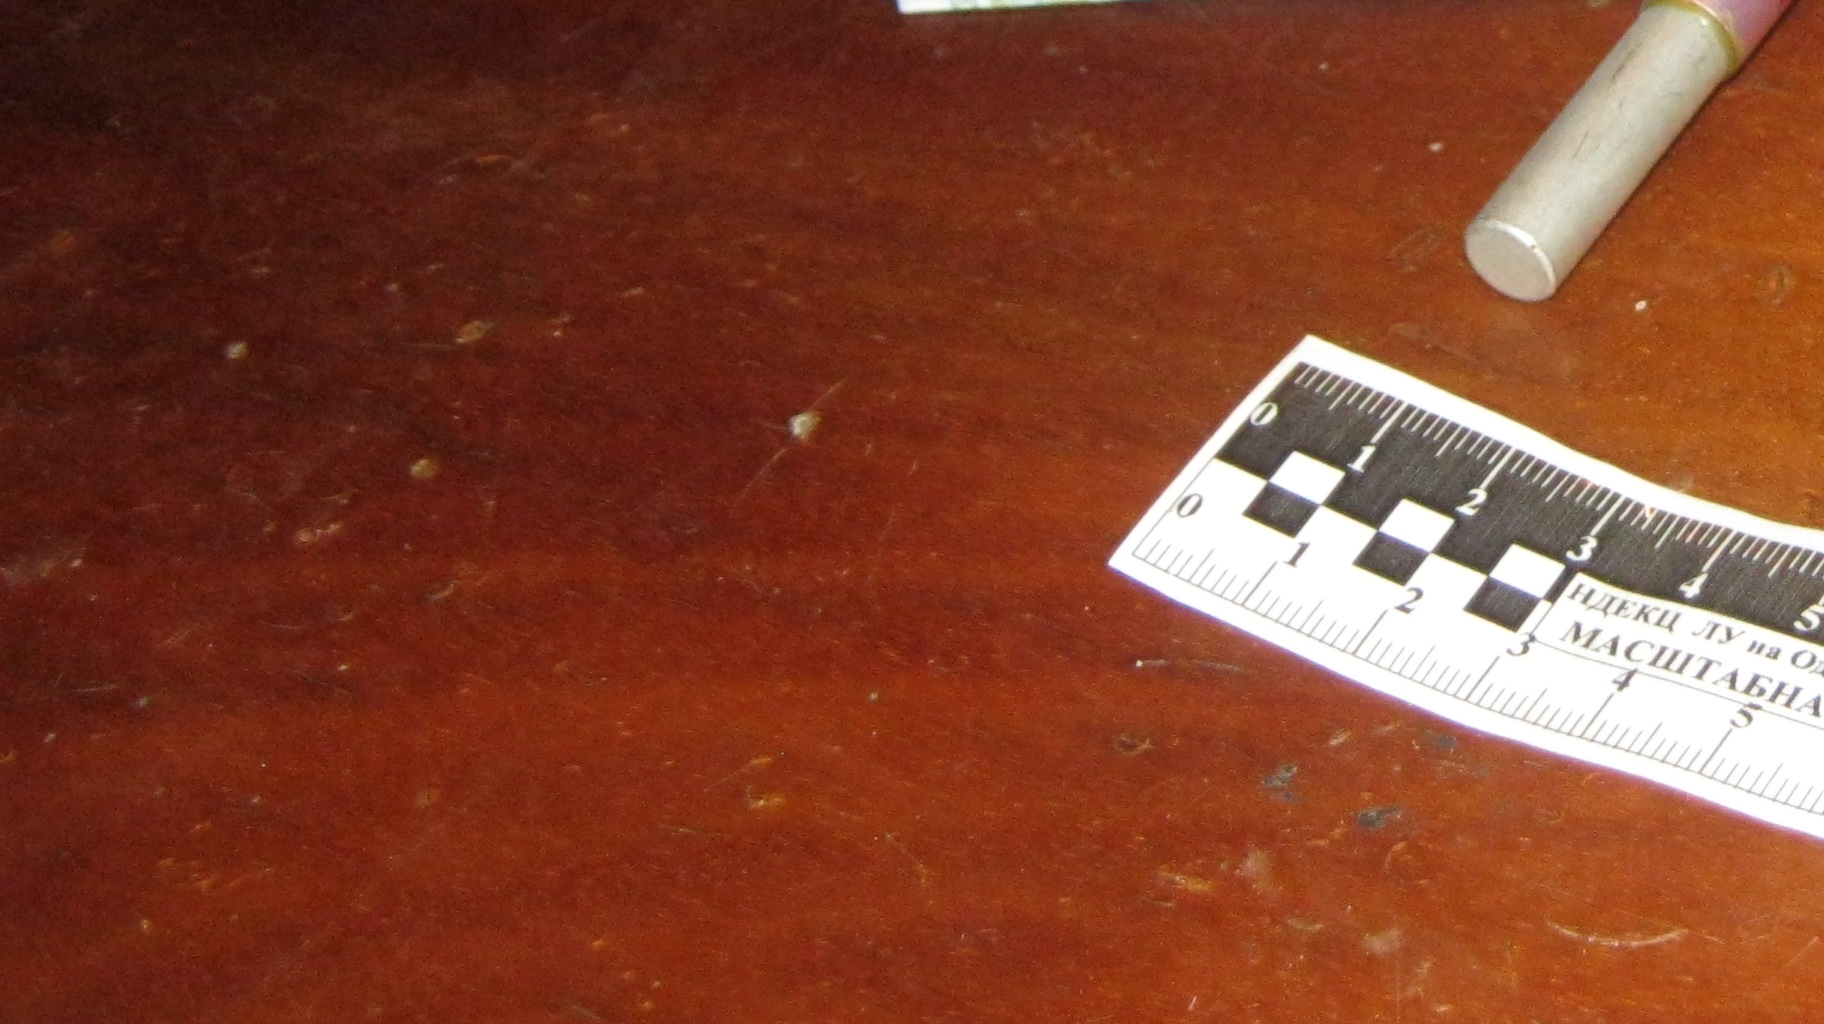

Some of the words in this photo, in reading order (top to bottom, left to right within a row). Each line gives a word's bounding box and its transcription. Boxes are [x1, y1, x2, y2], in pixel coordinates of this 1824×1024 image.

[1249, 402, 1279, 427] 0
[1346, 443, 1379, 474] 1
[1456, 488, 1488, 517] 2
[1566, 535, 1597, 563] 3
[1678, 573, 1708, 599] 4
[1176, 493, 1204, 519] 0
[1284, 542, 1313, 568] 1
[1394, 587, 1425, 614] 2
[1507, 633, 1537, 657] 3
[1611, 668, 1639, 692] 4
[1729, 701, 1763, 728] 5
[1559, 620, 1823, 718] МАСШТАБНА
[1566, 582, 1682, 634] НДЕКЦ
[1691, 620, 1746, 644] ЛУ
[1747, 639, 1782, 660] на
